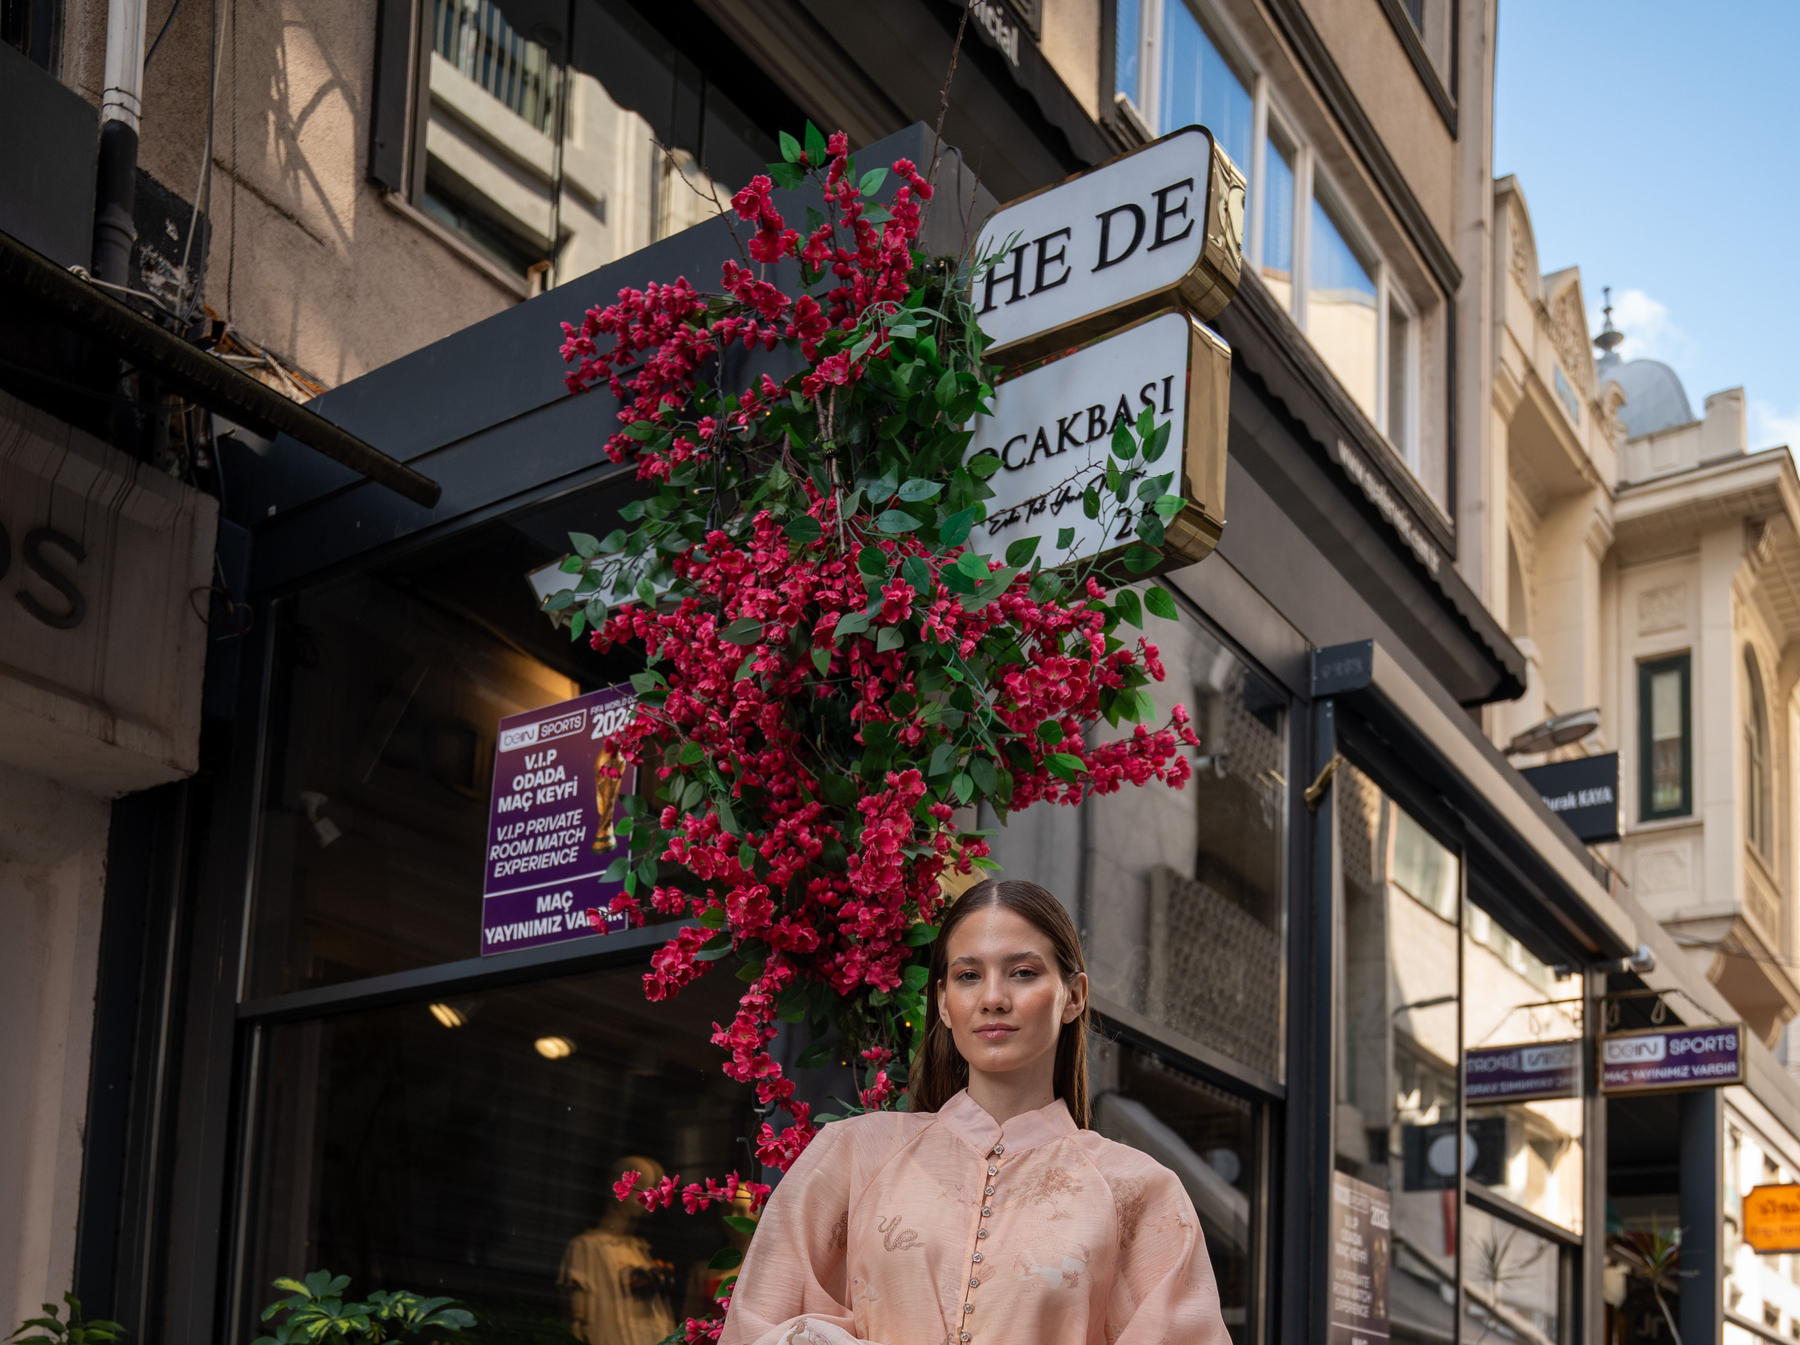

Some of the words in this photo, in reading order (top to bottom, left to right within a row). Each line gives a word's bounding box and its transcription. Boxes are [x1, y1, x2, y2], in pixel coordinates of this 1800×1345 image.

[975, 226, 1072, 315] HE
[1090, 177, 1195, 273] DE
[540, 716, 581, 737] SPORTS
[525, 748, 557, 770] V.I.P
[512, 765, 566, 791] ODADA
[498, 791, 534, 813] MAÇ
[536, 775, 578, 805] KEYFİ
[1578, 785, 1614, 808] KAYA
[497, 822, 525, 841] V.I.P
[525, 808, 583, 836] PRIVATE
[489, 838, 534, 861] ROOM
[535, 826, 586, 852] MATCH
[494, 846, 579, 878] EXPERIENCE
[536, 890, 574, 913] MAÇ
[484, 915, 562, 945] YAYINIMIZ
[1669, 1033, 1738, 1055] SPORTS
[1604, 1069, 1629, 1083] MAÇ
[1631, 1065, 1690, 1080] YAYINIMIZ
[1691, 1061, 1737, 1077] VARDIR
